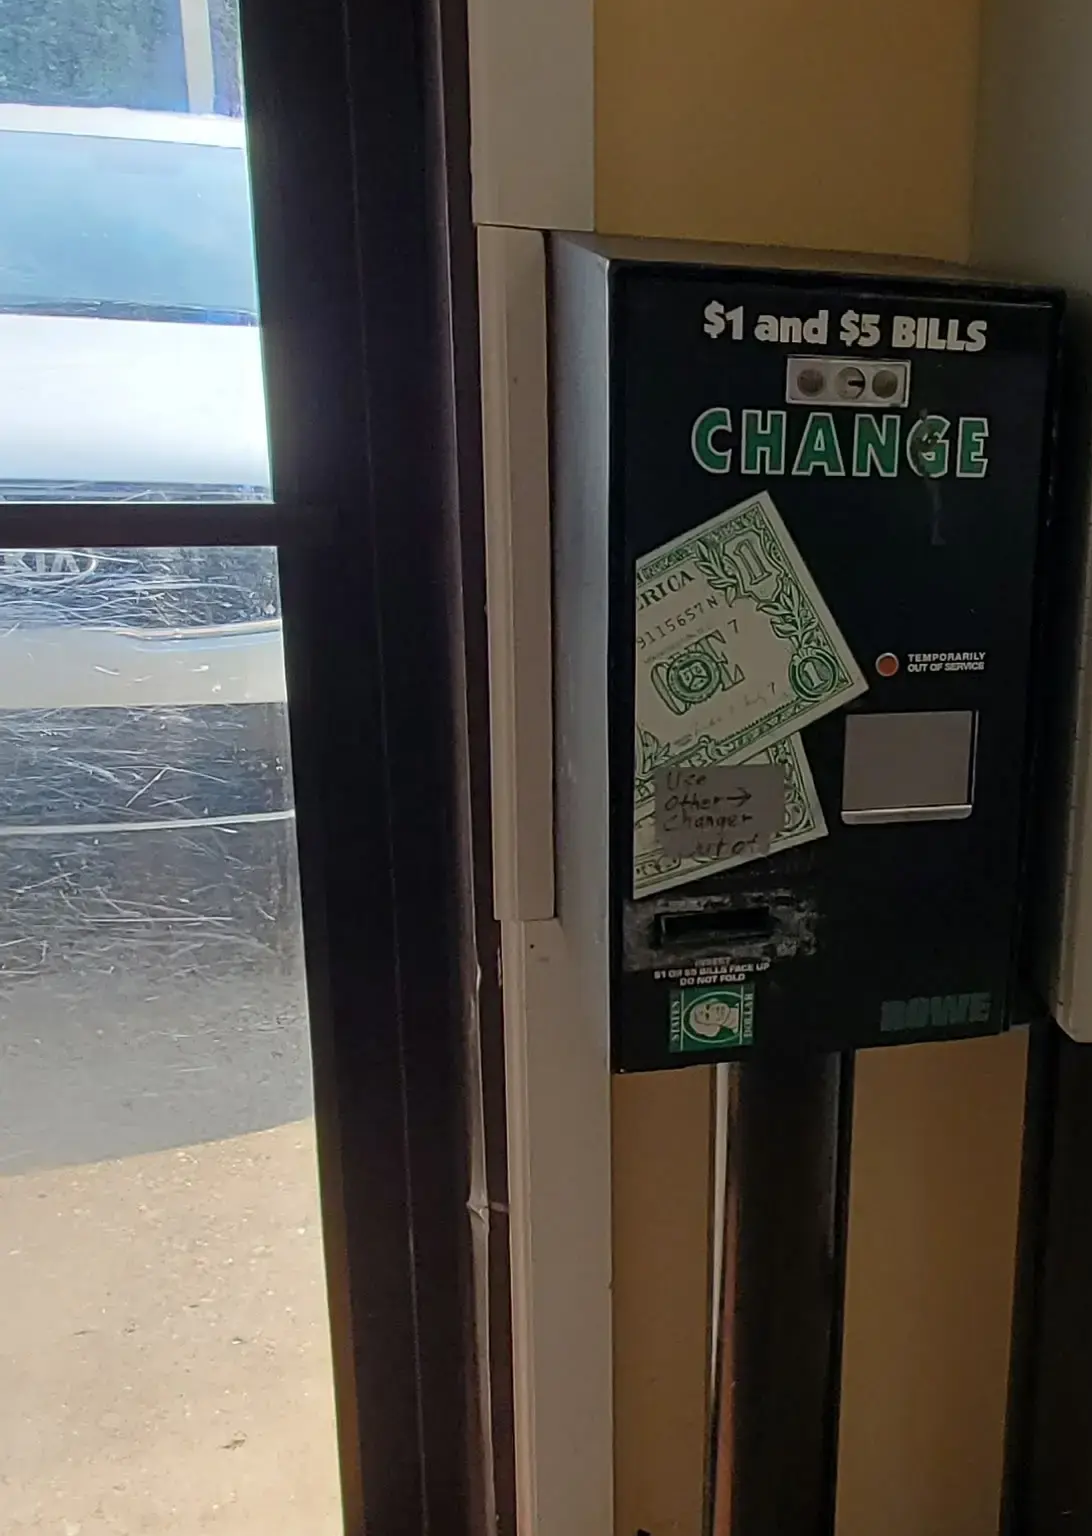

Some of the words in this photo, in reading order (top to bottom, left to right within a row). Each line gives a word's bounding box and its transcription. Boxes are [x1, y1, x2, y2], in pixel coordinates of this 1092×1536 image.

[703, 300, 743, 341] $1
[754, 310, 829, 345] and
[839, 310, 881, 347] $5
[891, 316, 988, 352] BILLS
[691, 407, 989, 479] CHANGE
[907, 652, 986, 663] TEMPORARILY
[907, 663, 928, 673] OUT
[930, 663, 943, 672] OF
[944, 661, 985, 672] SERVICE
[729, 963, 754, 973] FACE
[756, 962, 770, 971] UP
[680, 977, 695, 986] DO
[697, 975, 718, 985] NOT
[720, 973, 746, 982] FOLD
